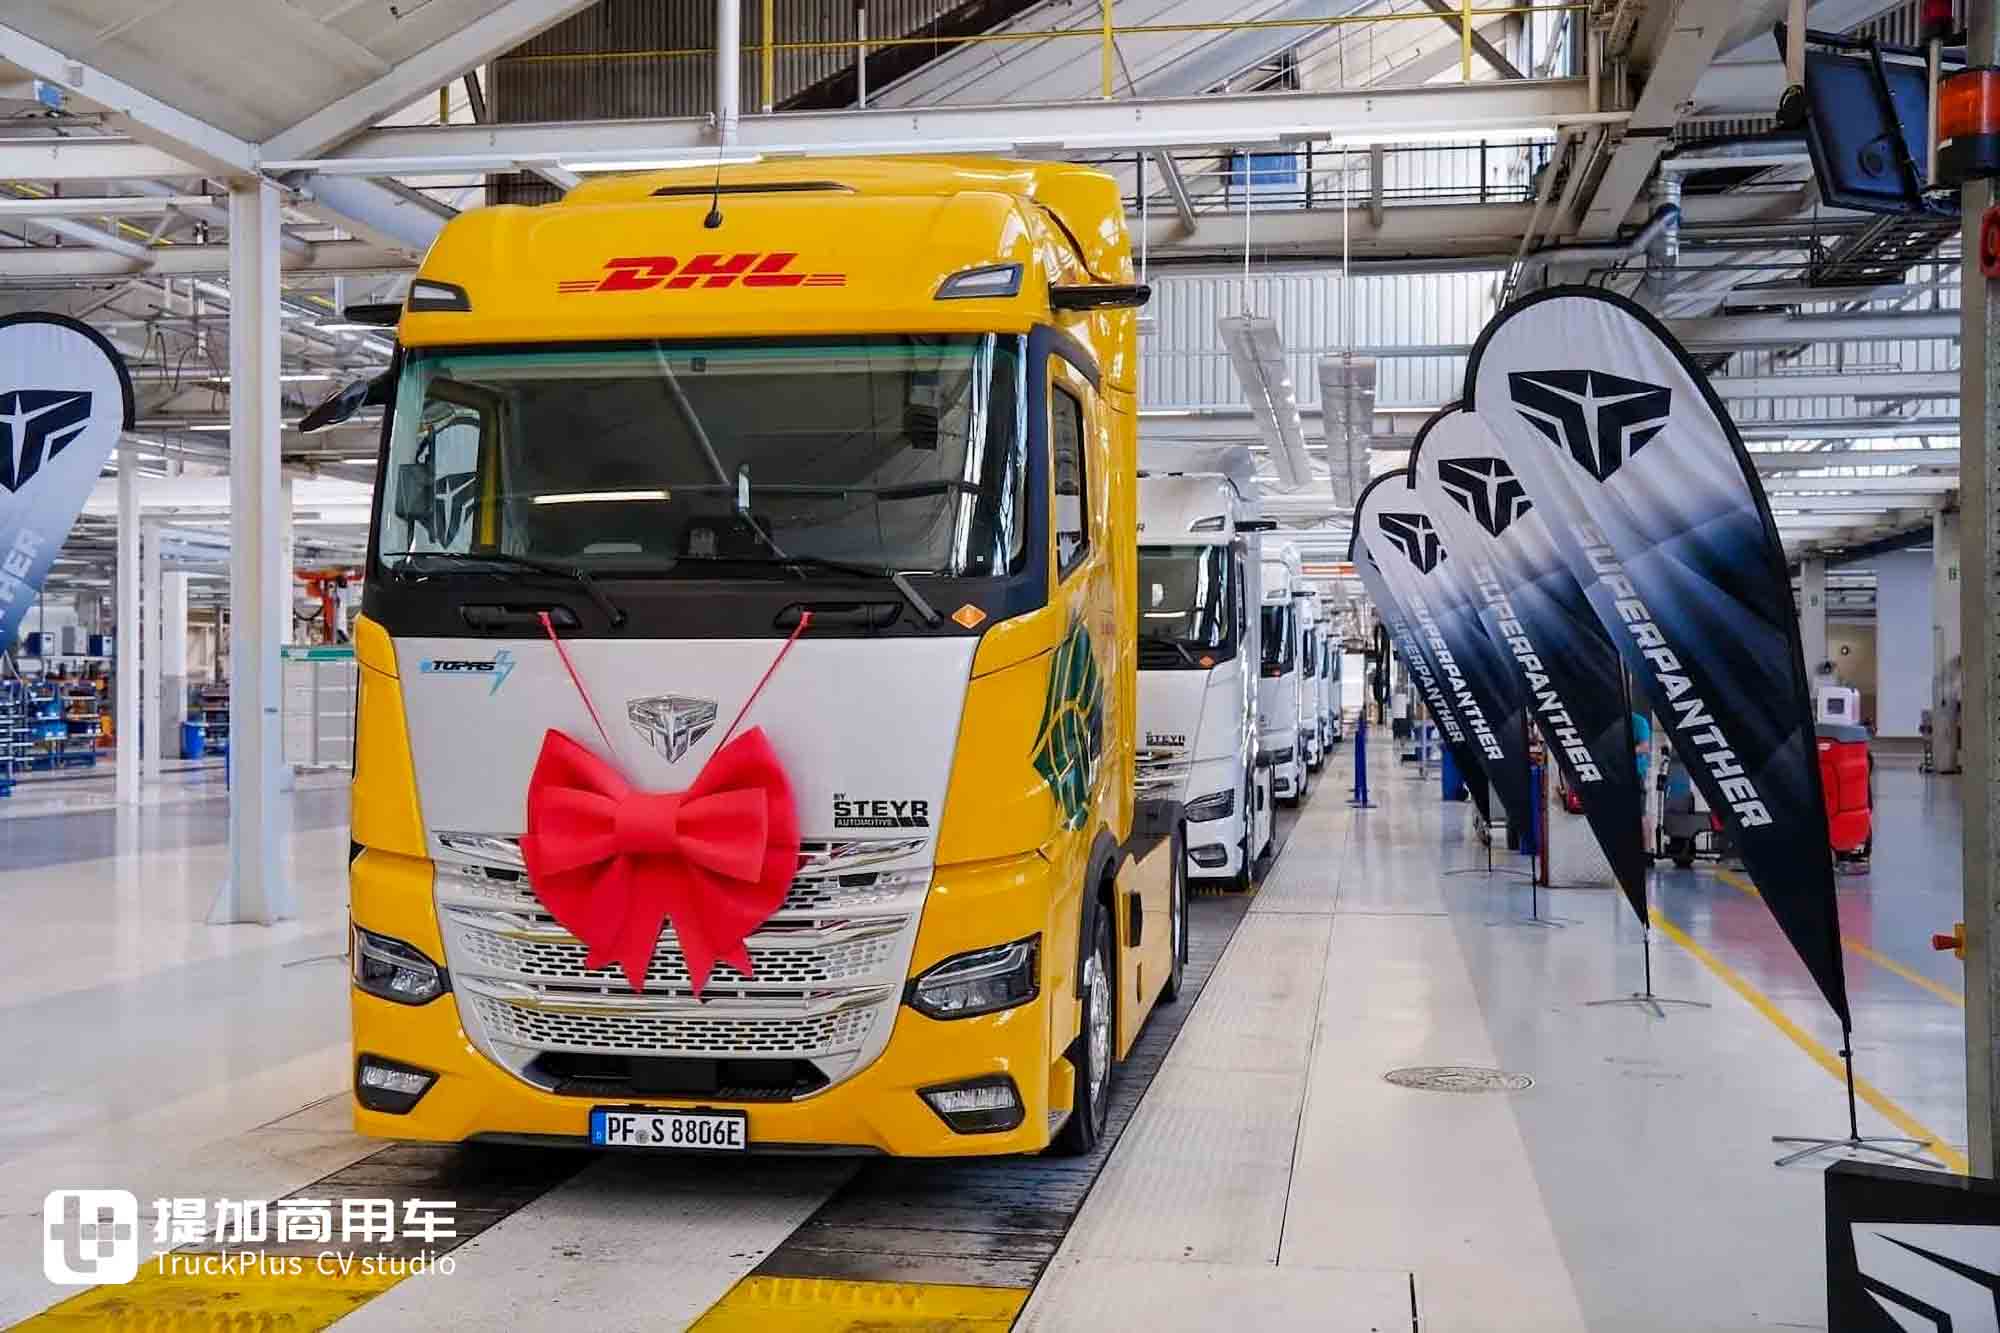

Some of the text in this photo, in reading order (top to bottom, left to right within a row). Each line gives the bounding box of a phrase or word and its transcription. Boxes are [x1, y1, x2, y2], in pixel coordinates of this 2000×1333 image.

[595, 252, 808, 292] DHL
[1471, 561, 1603, 784] SUPERPANTHER
[1569, 522, 1774, 829] SUPERPANTHER
[834, 800, 928, 817] STEYR
[608, 1117, 636, 1142] PF
[651, 1118, 664, 1143] S
[671, 1119, 741, 1146] 8806E
